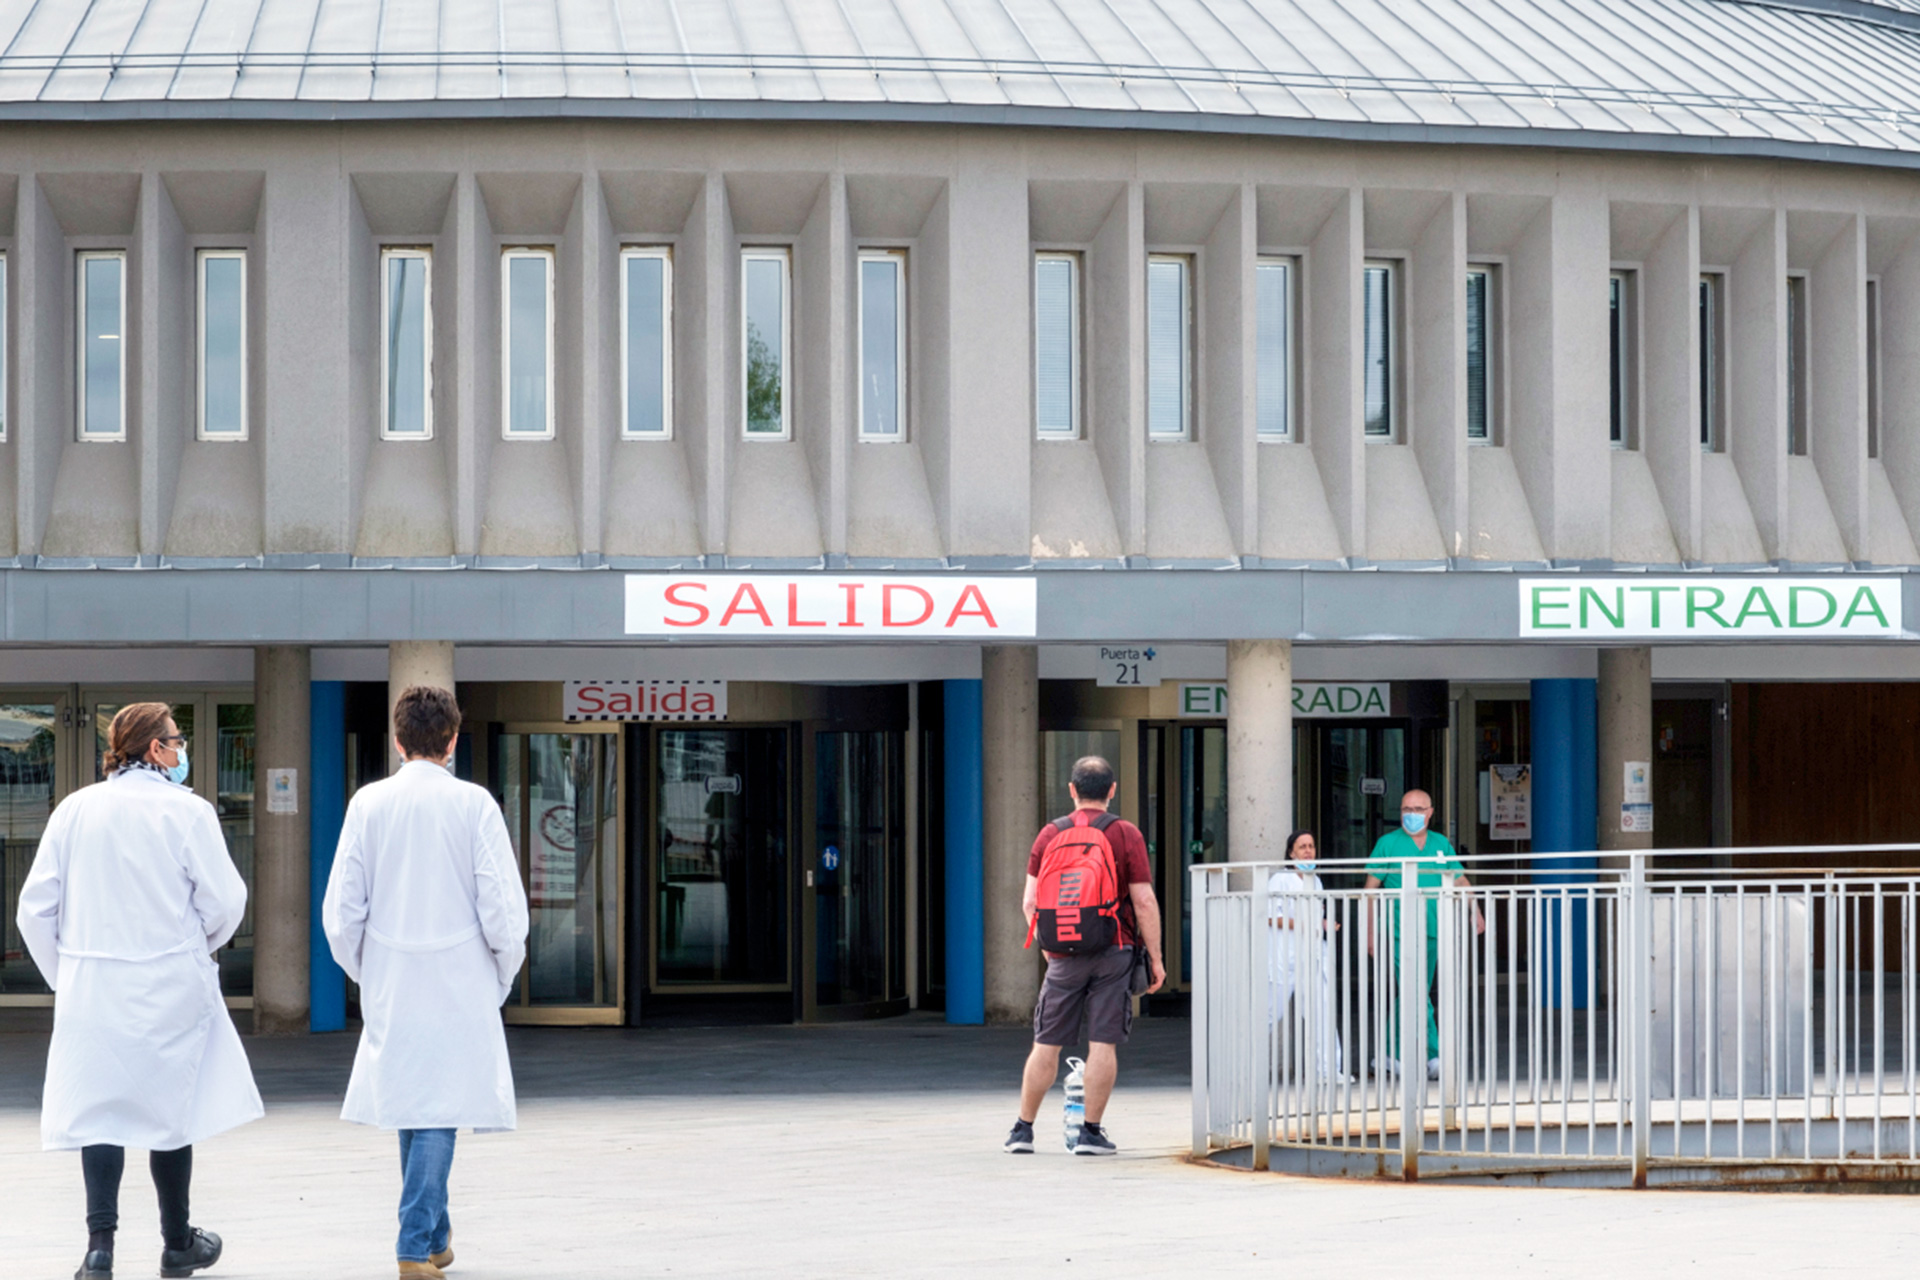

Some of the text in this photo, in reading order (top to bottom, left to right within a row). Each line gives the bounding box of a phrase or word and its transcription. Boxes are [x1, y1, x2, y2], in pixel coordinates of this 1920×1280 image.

[663, 582, 999, 628] SALIDA
[1531, 585, 1890, 629] ENTRADA
[1101, 647, 1140, 660] Puerta
[1116, 663, 1141, 684] 21
[577, 685, 715, 714] Salida
